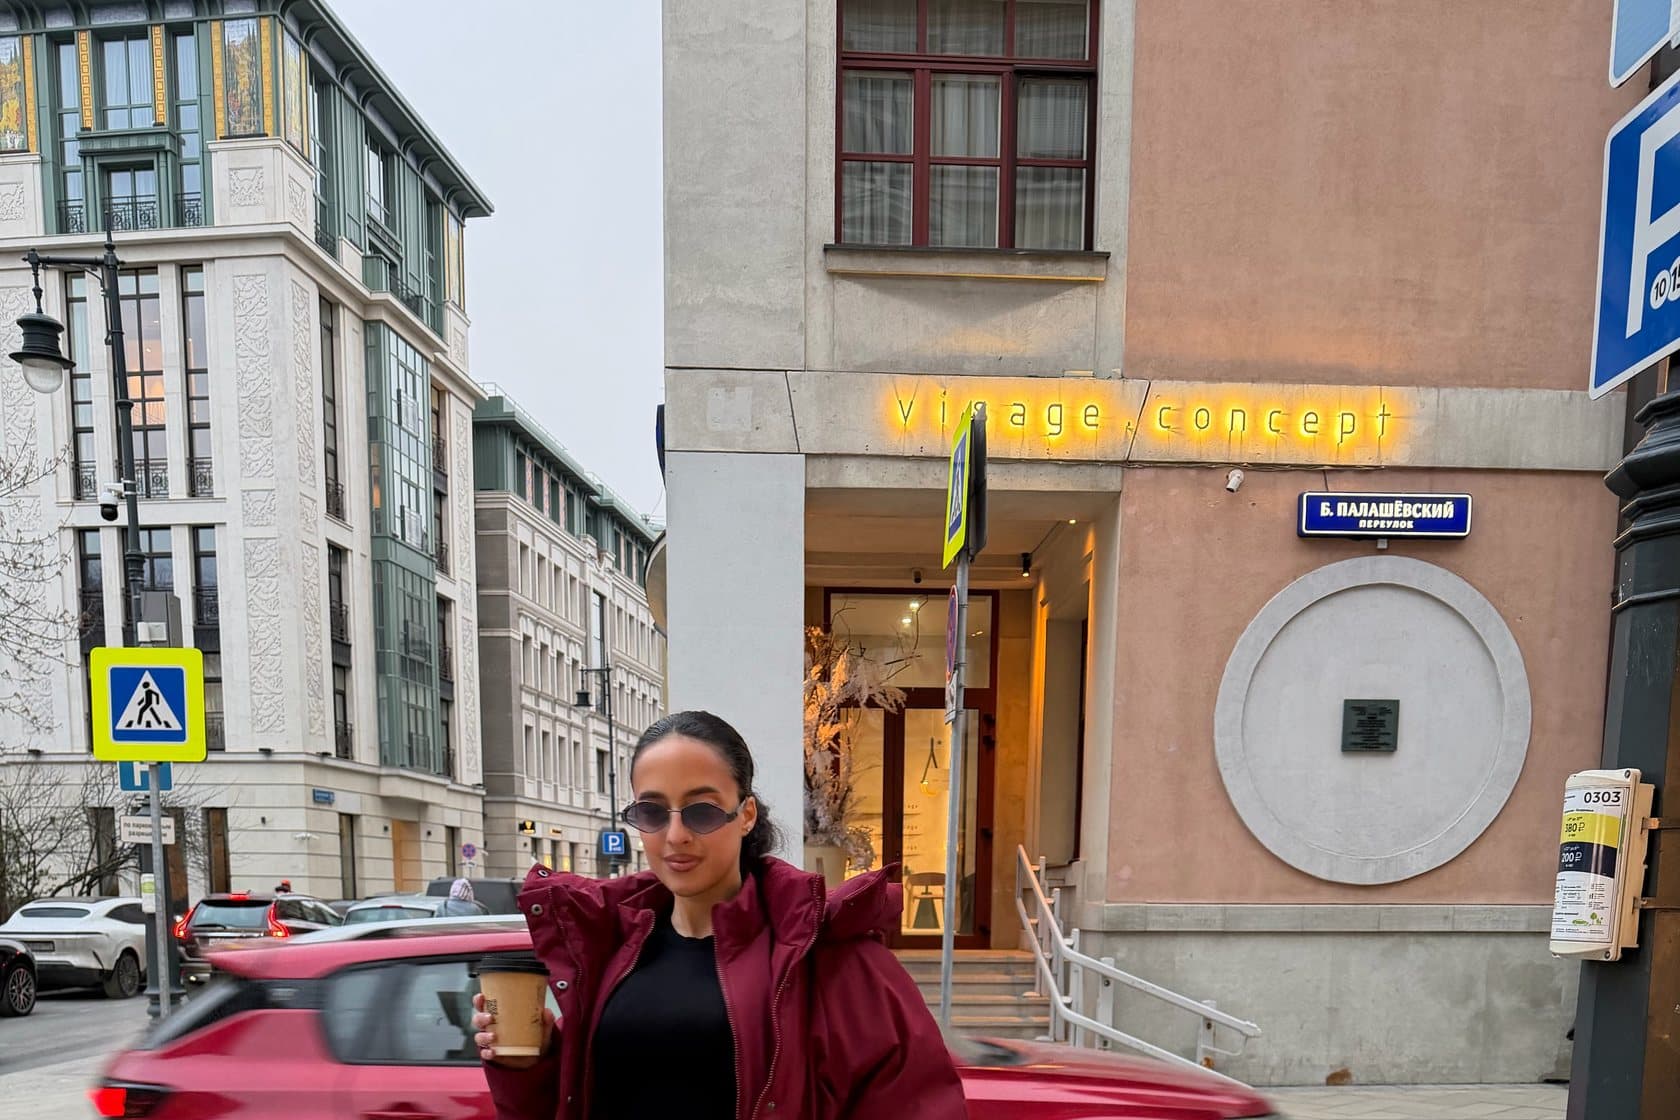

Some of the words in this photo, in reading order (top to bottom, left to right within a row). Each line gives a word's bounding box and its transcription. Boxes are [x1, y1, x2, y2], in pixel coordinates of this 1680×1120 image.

[1654, 277, 1667, 301] 10
[1158, 403, 1392, 444] concept
[1320, 502, 1334, 517] Б.
[1337, 500, 1455, 519] ПАЛАШЁВСКИЙ
[1359, 519, 1414, 529] ПЕРЕУЛОК
[1583, 791, 1621, 804] 0303
